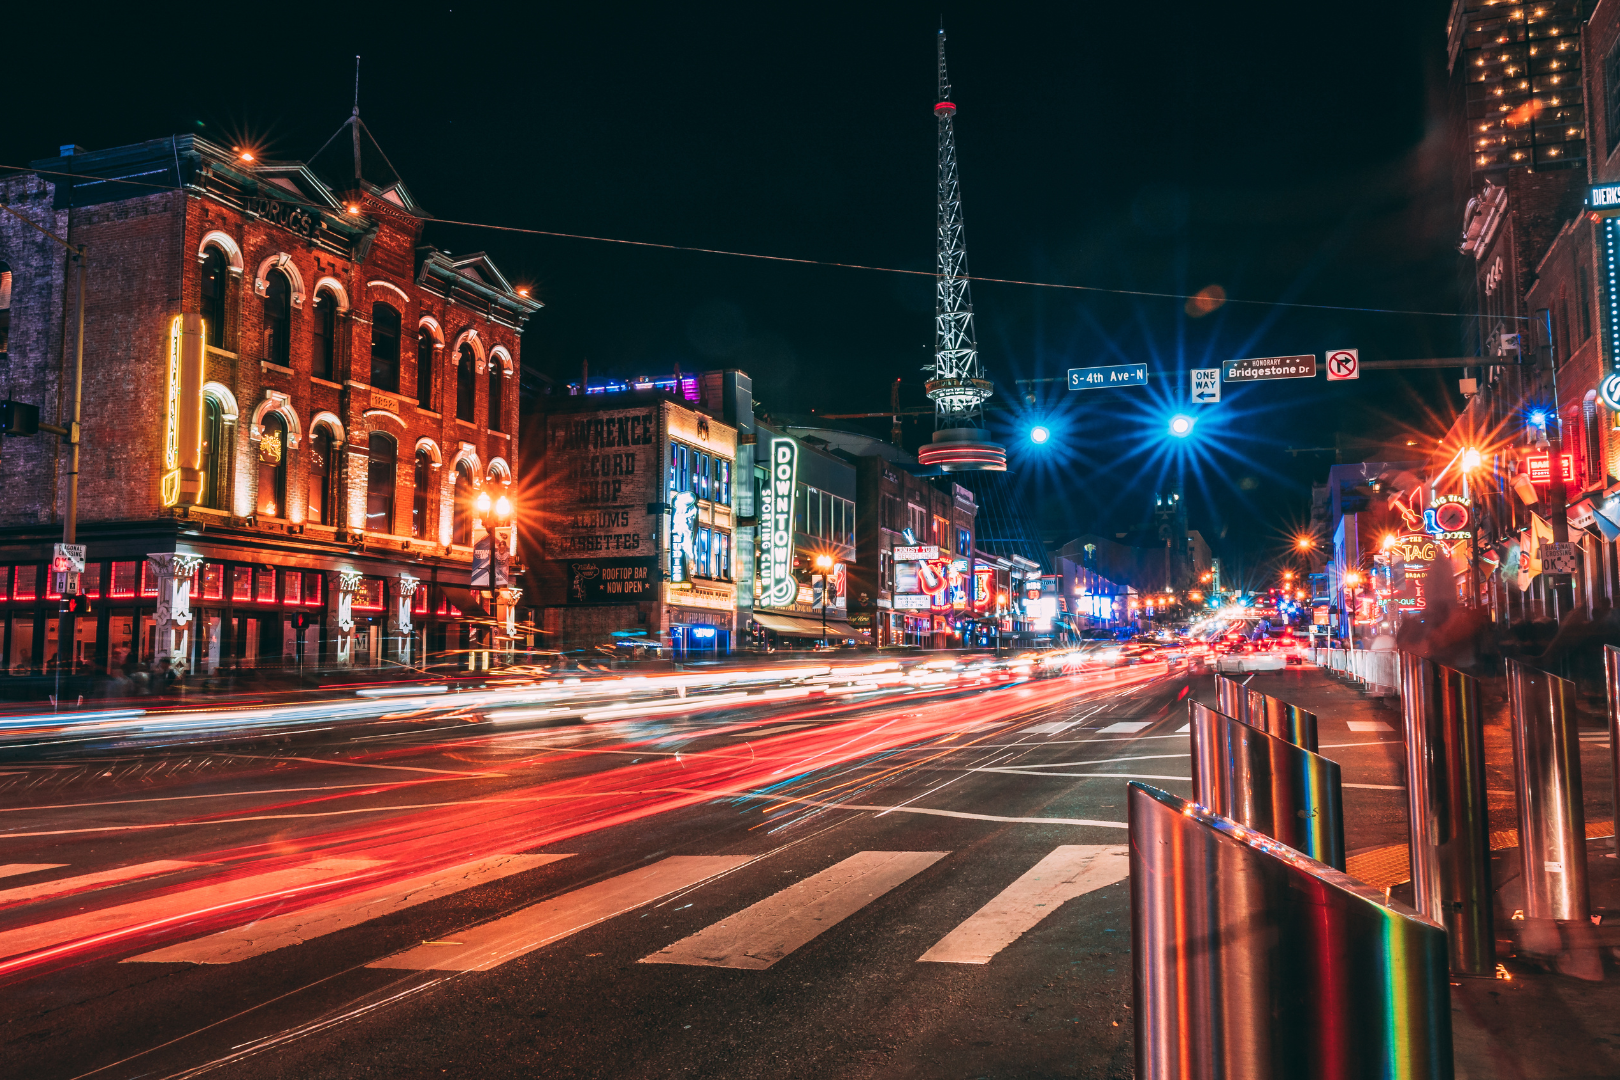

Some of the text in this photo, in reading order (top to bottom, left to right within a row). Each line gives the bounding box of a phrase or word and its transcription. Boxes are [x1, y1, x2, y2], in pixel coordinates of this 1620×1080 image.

[258, 200, 312, 236] DRUGS
[1252, 359, 1281, 367] HONORARY
[1072, 369, 1143, 385] S-4th Ave-N
[1196, 371, 1216, 380] ONE
[1229, 366, 1297, 378] Bridgestone
[1195, 381, 1216, 389] WAY
[547, 413, 653, 450] LAWRENCE
[567, 452, 636, 479] RECORD
[576, 480, 622, 503] SHOP
[1430, 494, 1472, 508] BIG TIME
[572, 511, 629, 529] ALBUMS
[760, 488, 772, 551] SPORTING
[774, 447, 792, 580] DOWNTOWN
[560, 533, 640, 552] CASSETTES
[1435, 531, 1472, 540] BOOTS
[1545, 543, 1572, 551] DIAGONAL
[1545, 549, 1572, 557] CROSSING
[760, 553, 772, 587] CLUB
[1543, 558, 1557, 570] OK
[602, 567, 648, 580] ROOFTOP BAR
[607, 581, 642, 593] NOW OPEN
